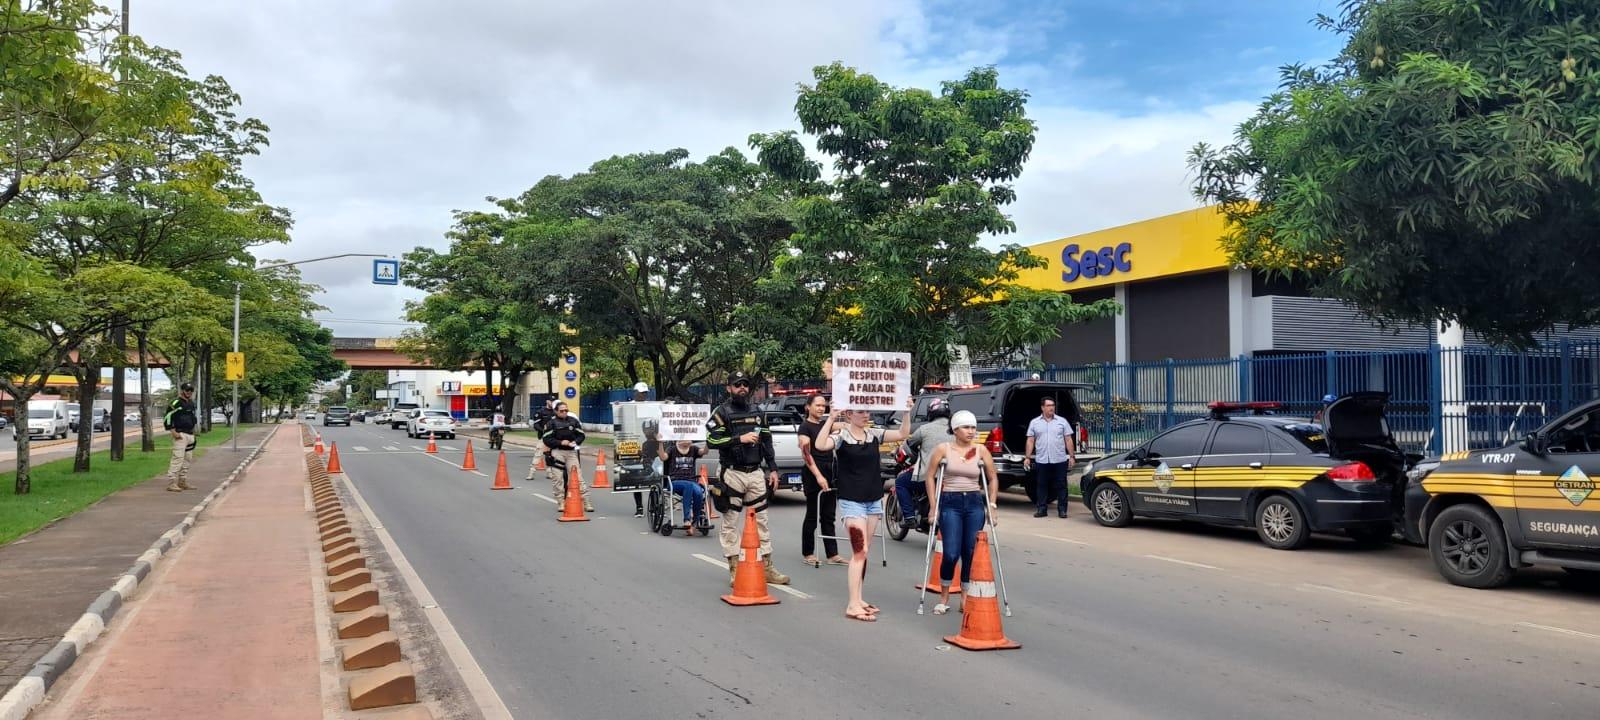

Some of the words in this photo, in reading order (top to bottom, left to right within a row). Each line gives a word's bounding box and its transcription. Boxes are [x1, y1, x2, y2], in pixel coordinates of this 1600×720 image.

[1062, 243, 1131, 282] Sesc
[837, 358, 887, 369] MOTORISTA
[889, 358, 907, 369] NÃO
[849, 371, 895, 381] RESPEITOU
[849, 383, 855, 392] A
[857, 383, 884, 393] FAIXA
[885, 384, 896, 393] DE
[849, 395, 894, 405] PEDESTRE!
[1482, 453, 1516, 463] VTR-07
[1555, 481, 1595, 489] DETRAN
[1530, 521, 1599, 537] SEGURANÇA
